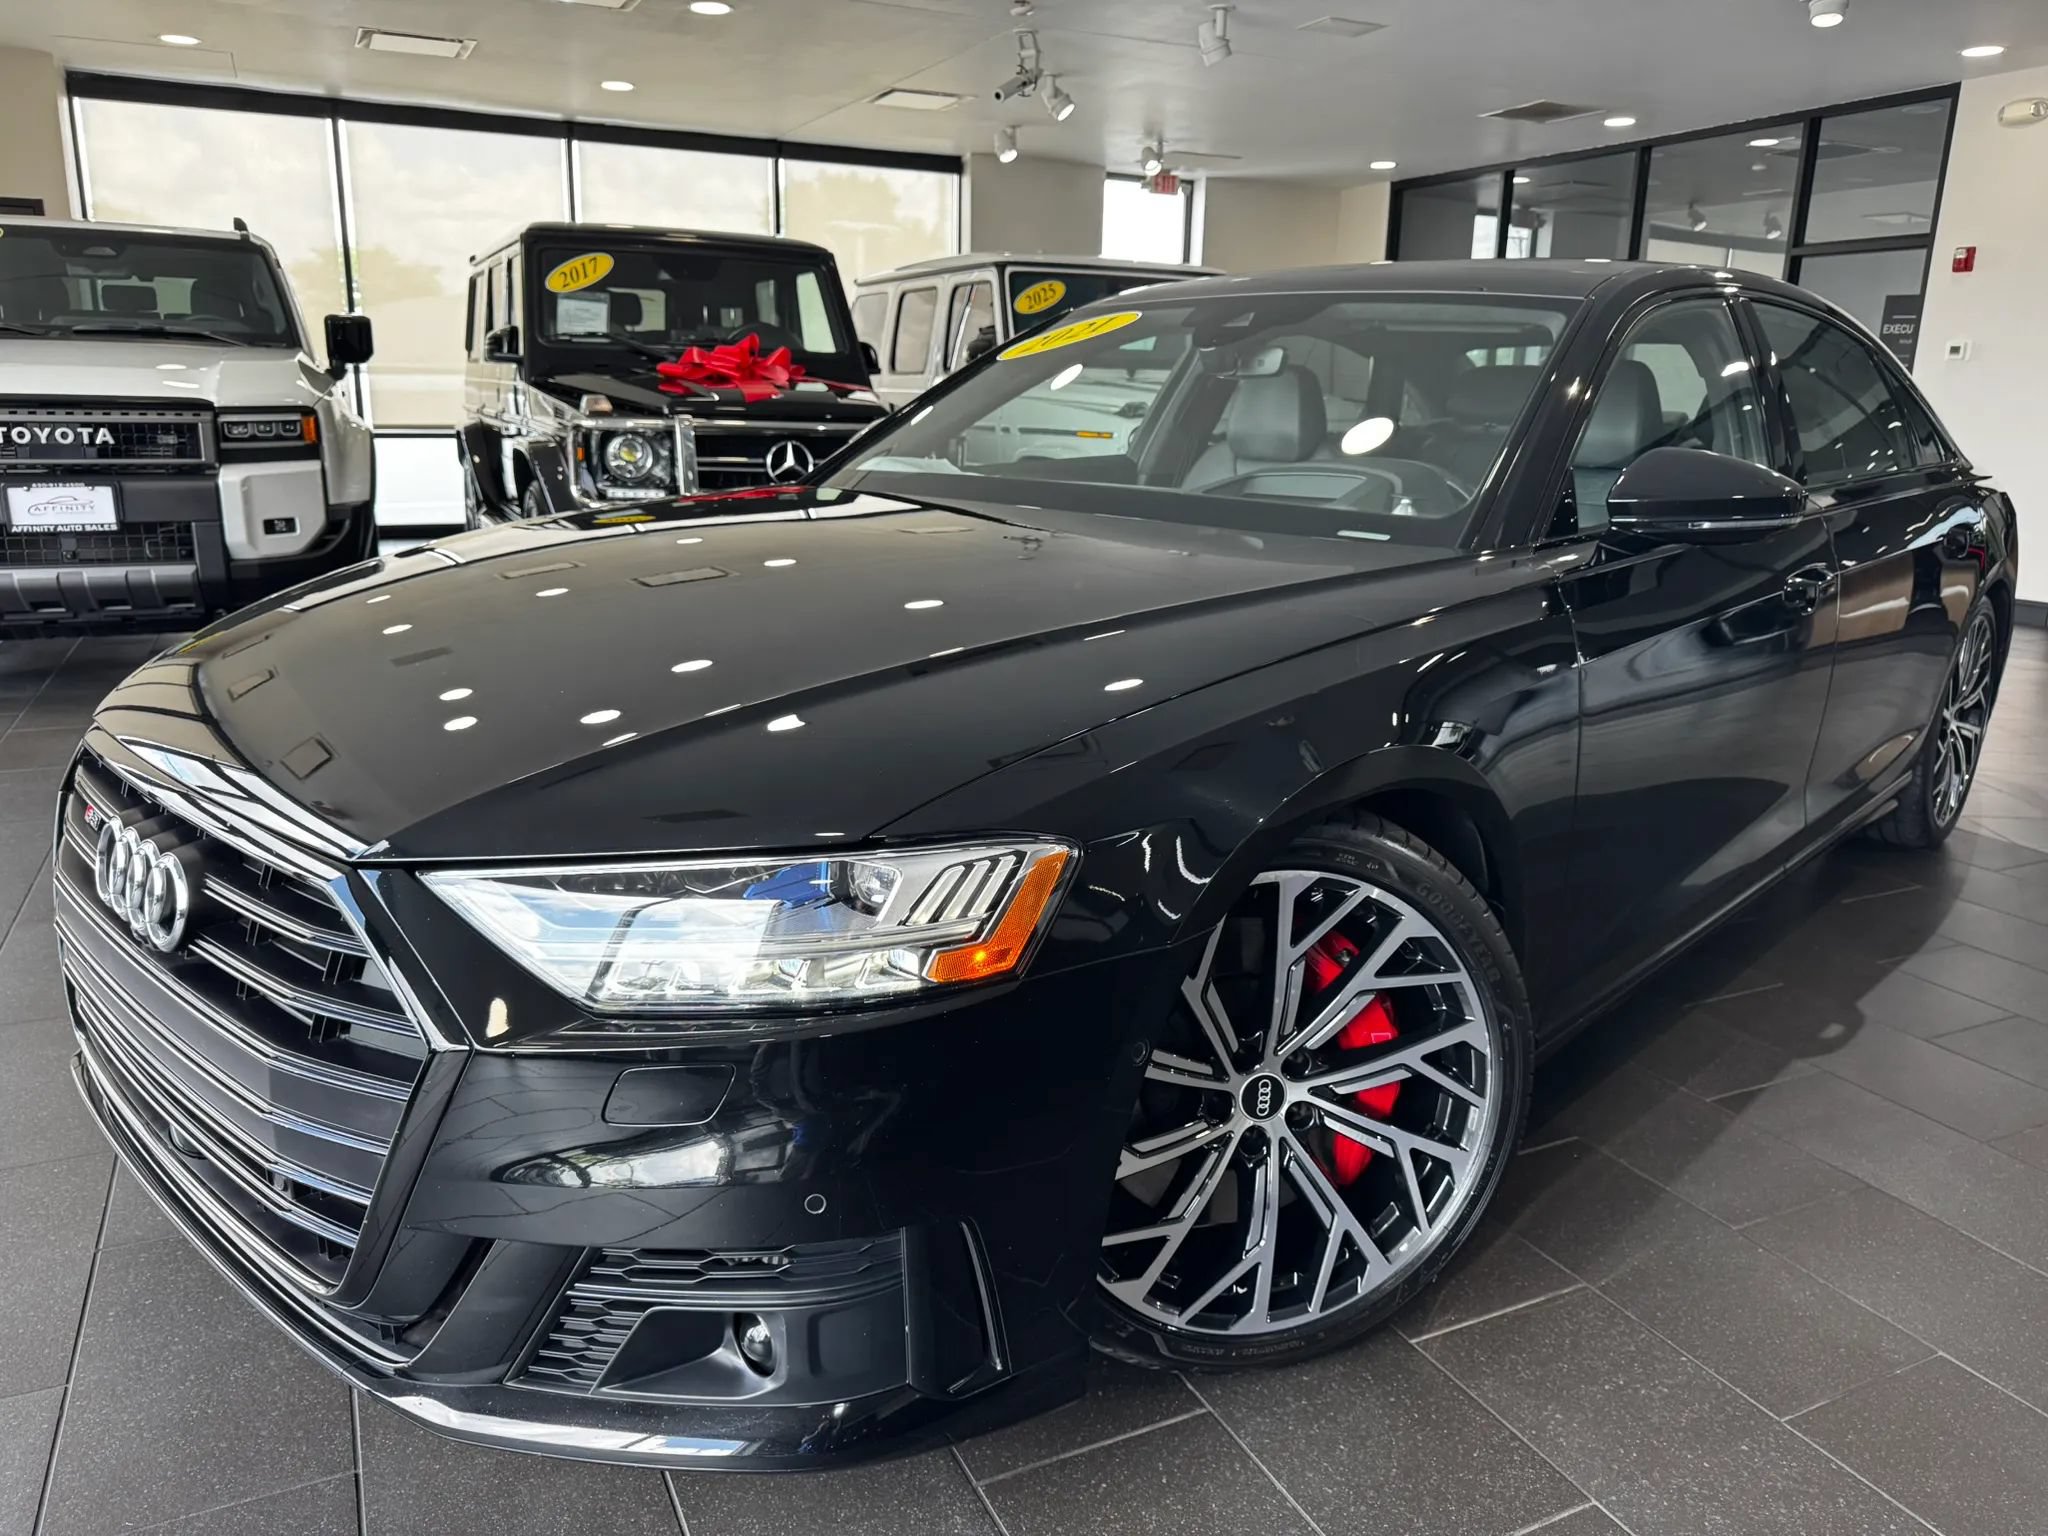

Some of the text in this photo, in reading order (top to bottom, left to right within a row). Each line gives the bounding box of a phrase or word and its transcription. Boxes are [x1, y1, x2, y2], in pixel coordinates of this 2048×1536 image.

[558, 256, 598, 288] 2017
[1026, 283, 1058, 310] 2025
[34, 504, 95, 512] AFFINITY
[11, 523, 118, 533] AFFINITY AUTO SALES
[1416, 881, 1502, 984] GOODYEAR
